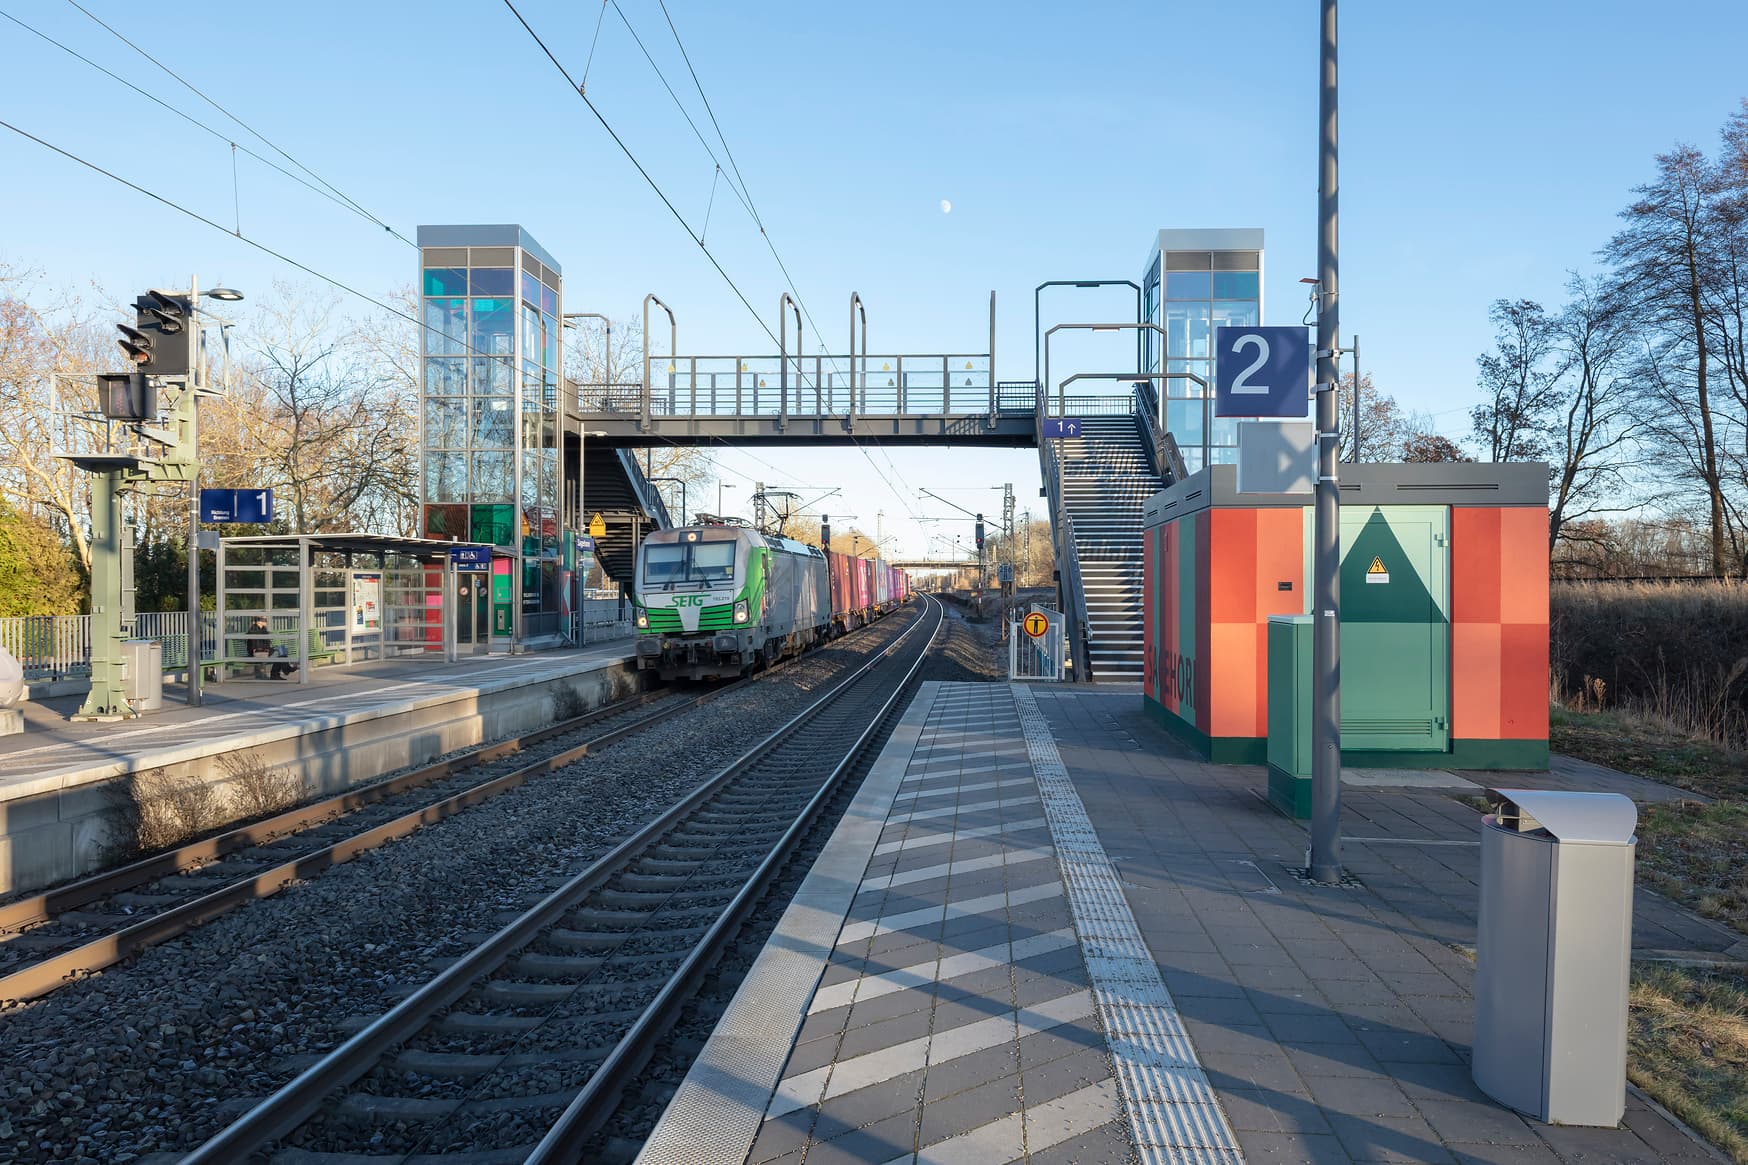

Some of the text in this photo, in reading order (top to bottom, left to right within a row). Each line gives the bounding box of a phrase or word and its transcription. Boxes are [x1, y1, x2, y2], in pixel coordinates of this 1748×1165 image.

[1230, 334, 1270, 394] 2
[1057, 421, 1063, 432] 1
[256, 492, 266, 515] 1
[667, 594, 710, 607] SETG
